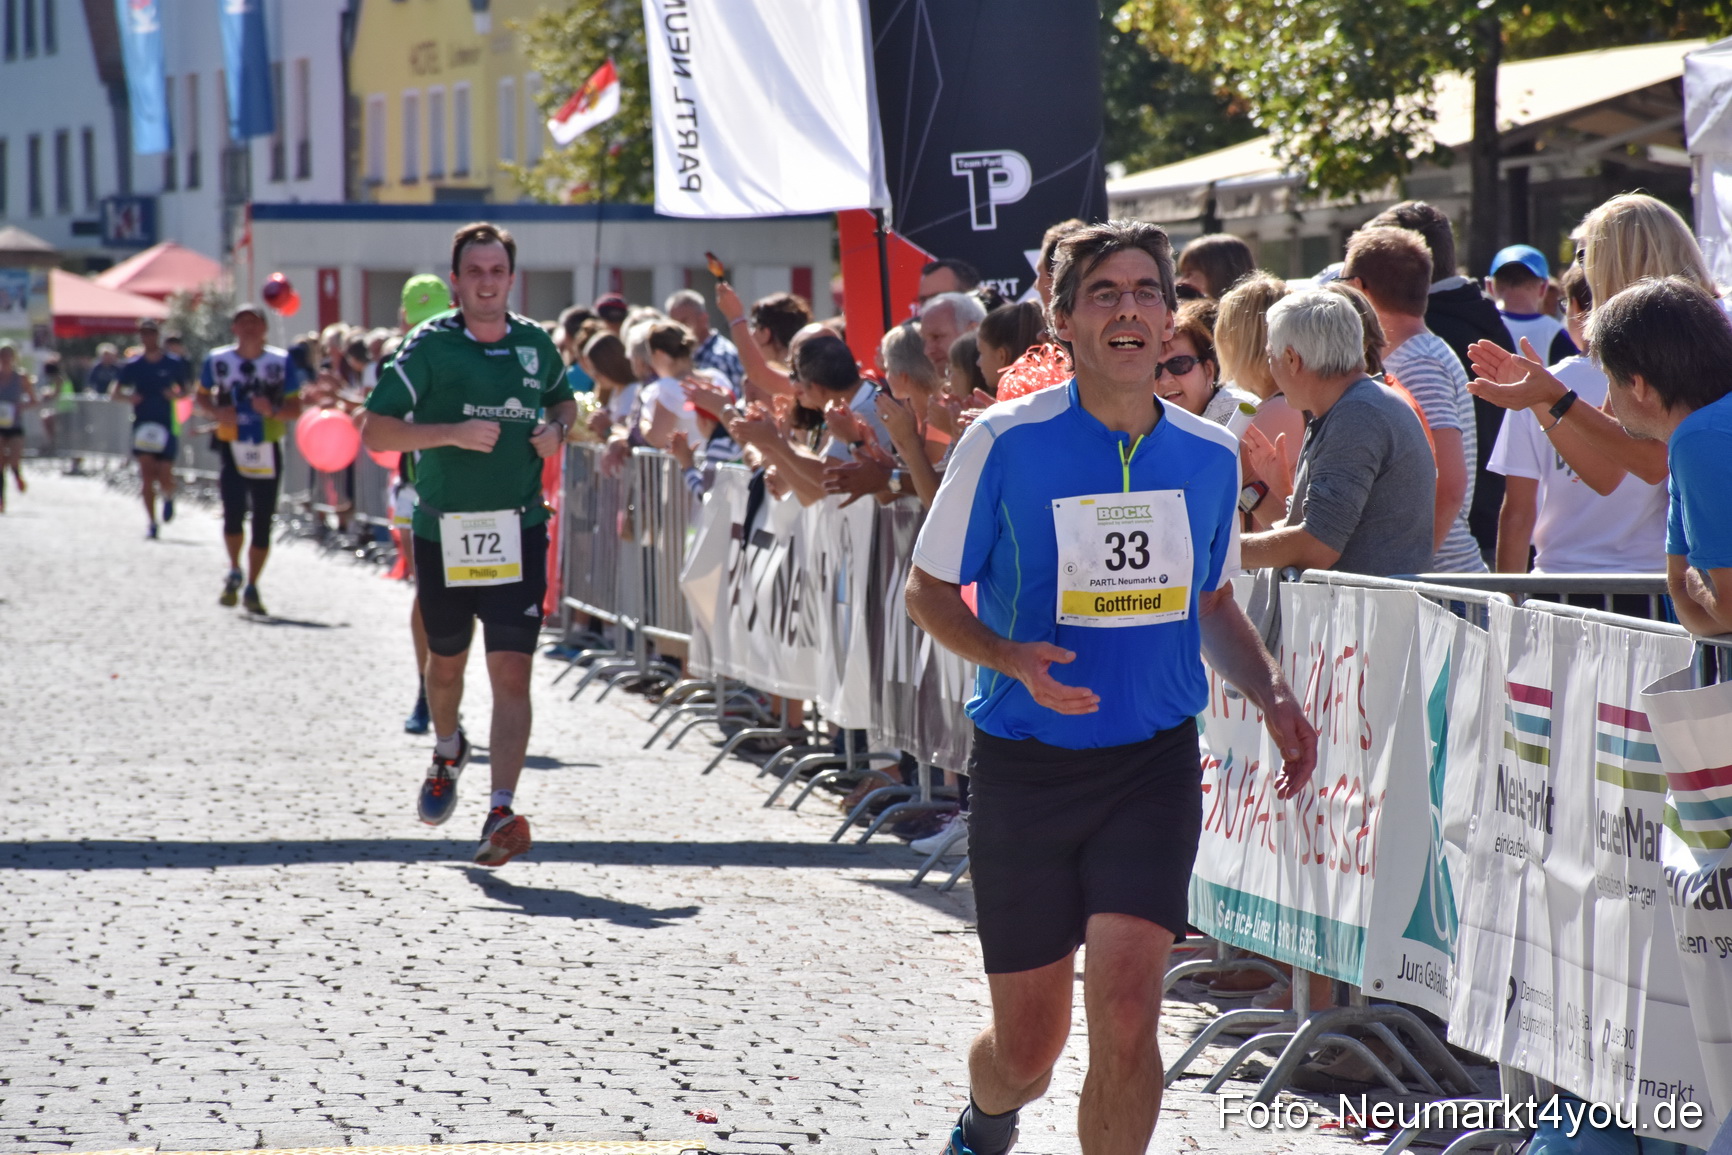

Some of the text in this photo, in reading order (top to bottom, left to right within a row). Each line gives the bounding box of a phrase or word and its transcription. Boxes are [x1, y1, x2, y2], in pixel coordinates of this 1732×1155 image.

[1096, 505, 1153, 521] BOCK
[460, 532, 502, 556] 172
[1105, 530, 1150, 572] 33
[469, 568, 498, 579] Phillip
[1089, 576, 1157, 587] PARTL Neumarkt
[1094, 593, 1162, 613] Gottfried
[1397, 953, 1423, 984] Jura
